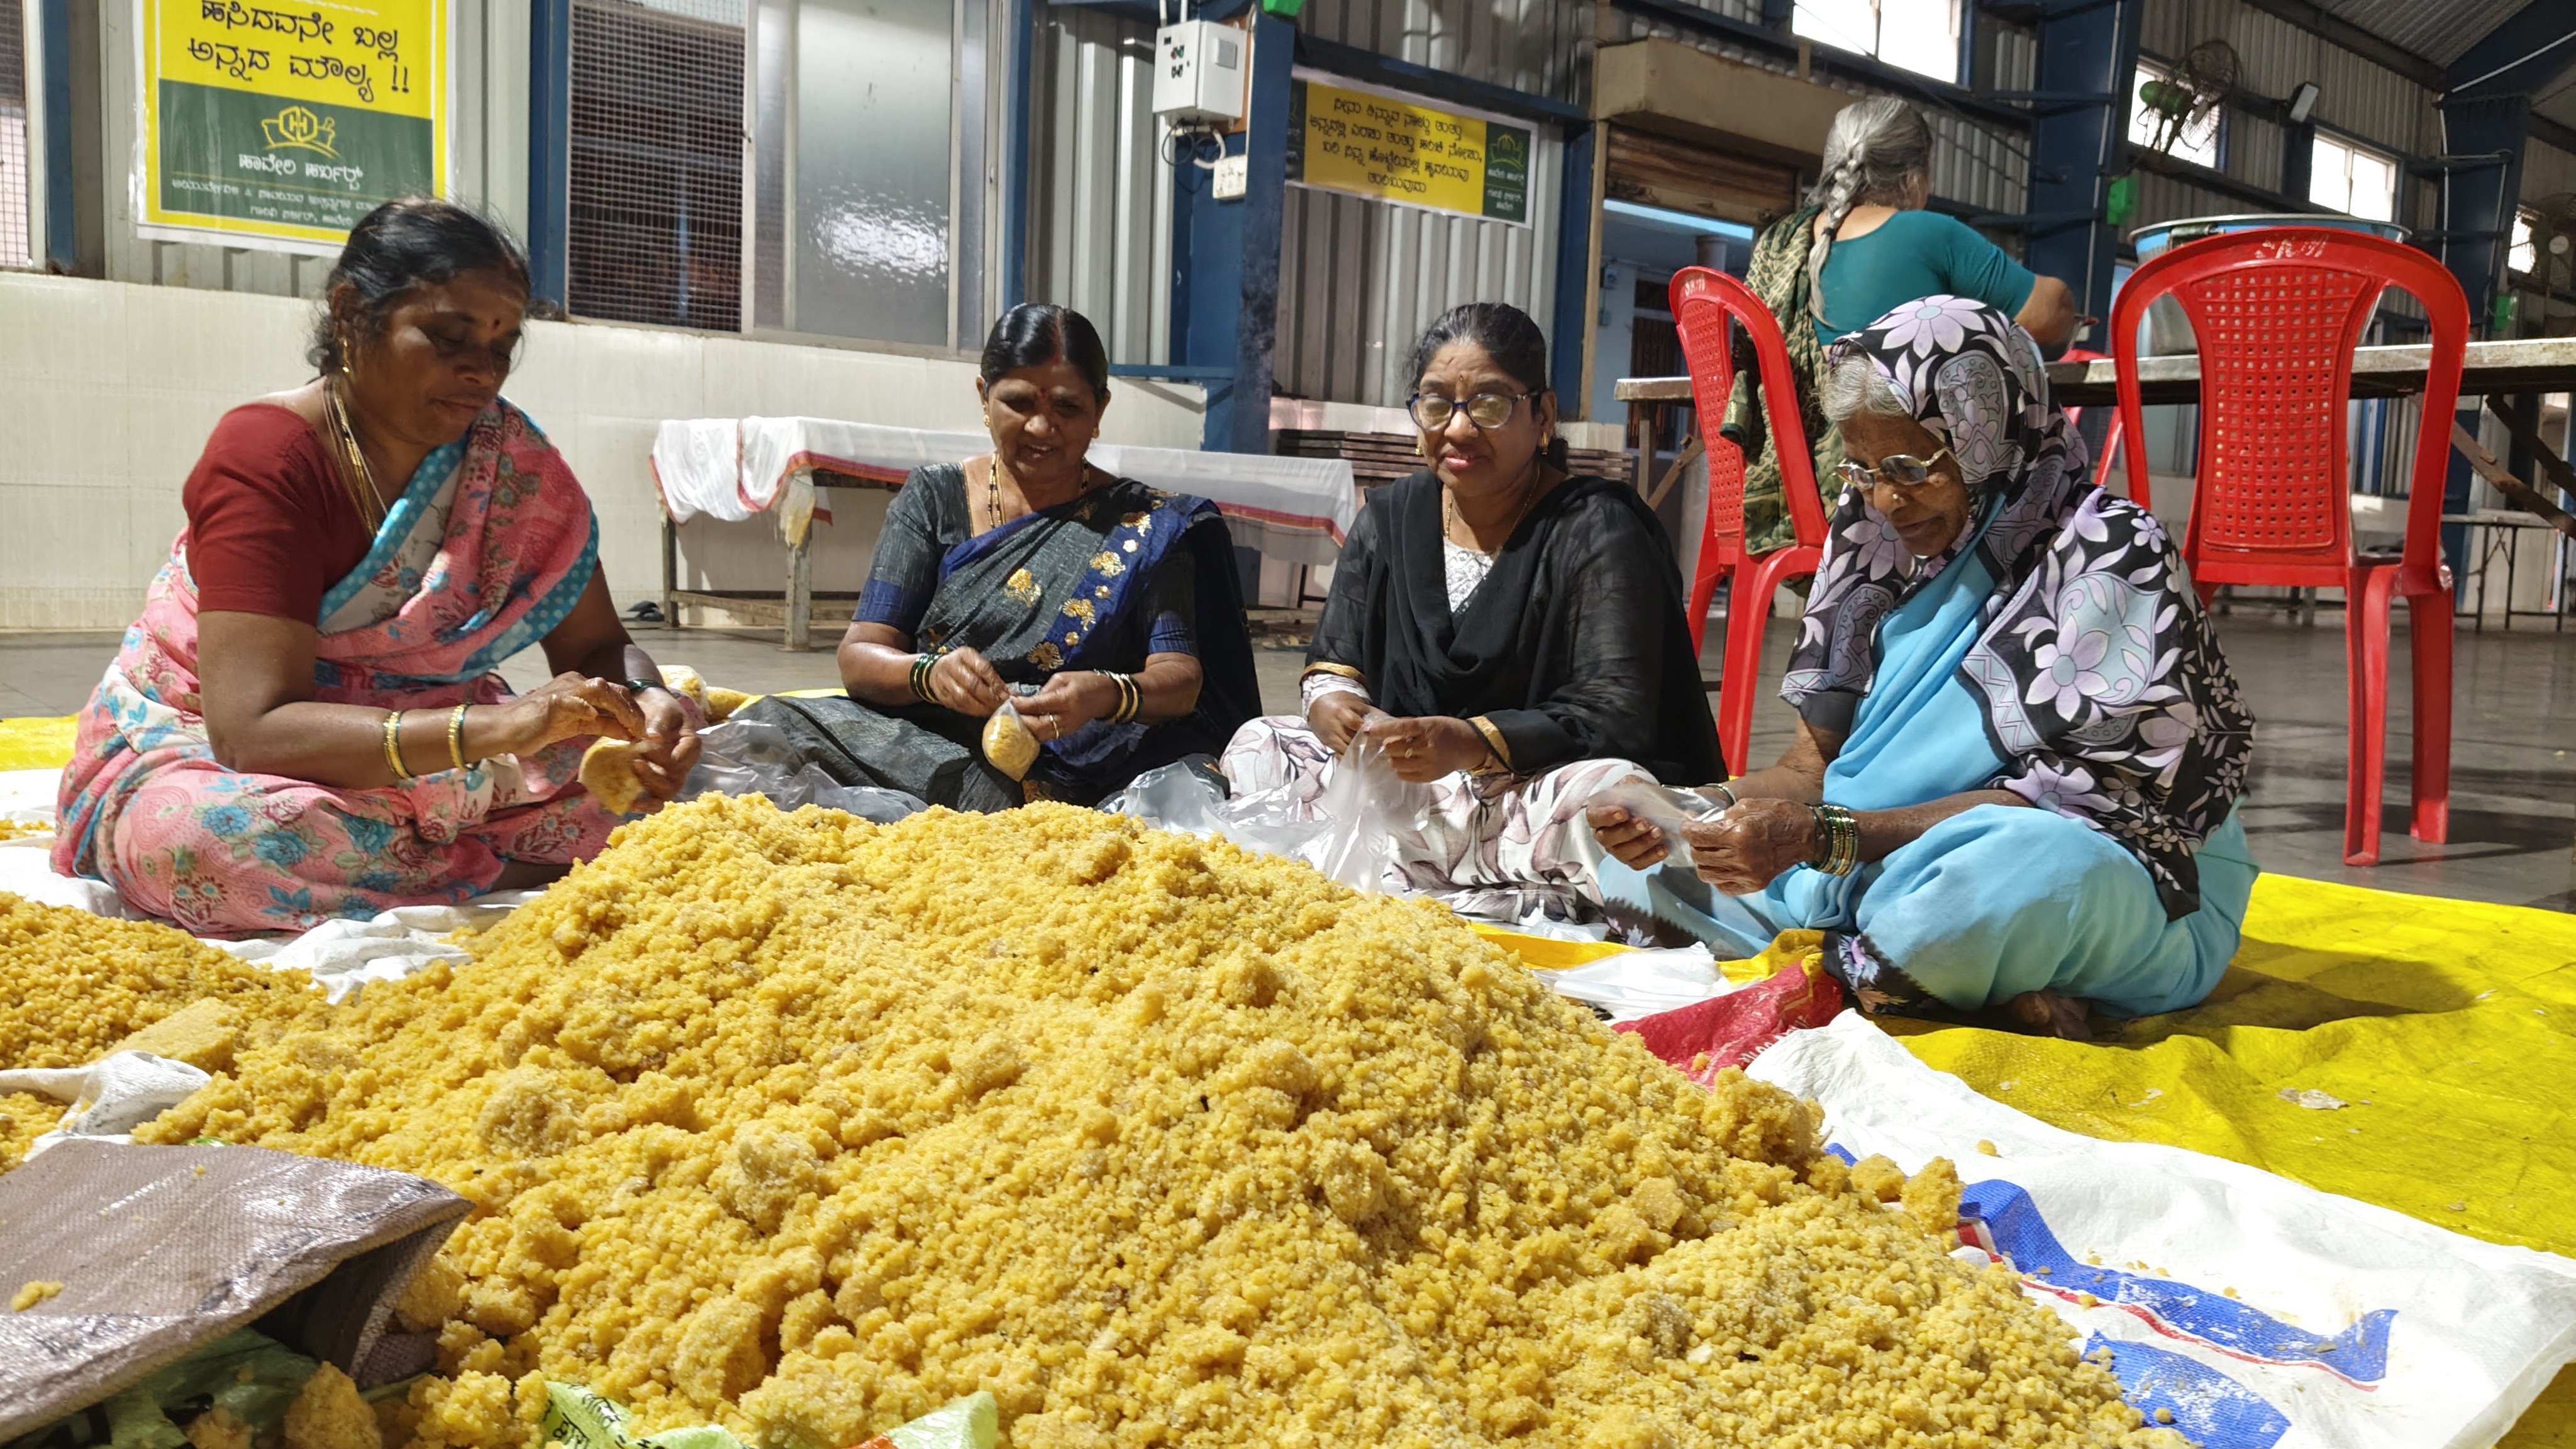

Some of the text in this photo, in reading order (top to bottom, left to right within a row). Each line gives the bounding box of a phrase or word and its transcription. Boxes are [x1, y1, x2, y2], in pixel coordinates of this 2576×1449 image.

[201, 0, 398, 62] ಹಸಿದವನೇ ಬಲ್ಲ
[187, 38, 270, 82] ಅನ್ನದ
[290, 55, 375, 103] ಮೌಲ್ಯ
[1334, 98, 1362, 115] ನೀನು
[239, 153, 297, 175] ಹಾವೇರಿ
